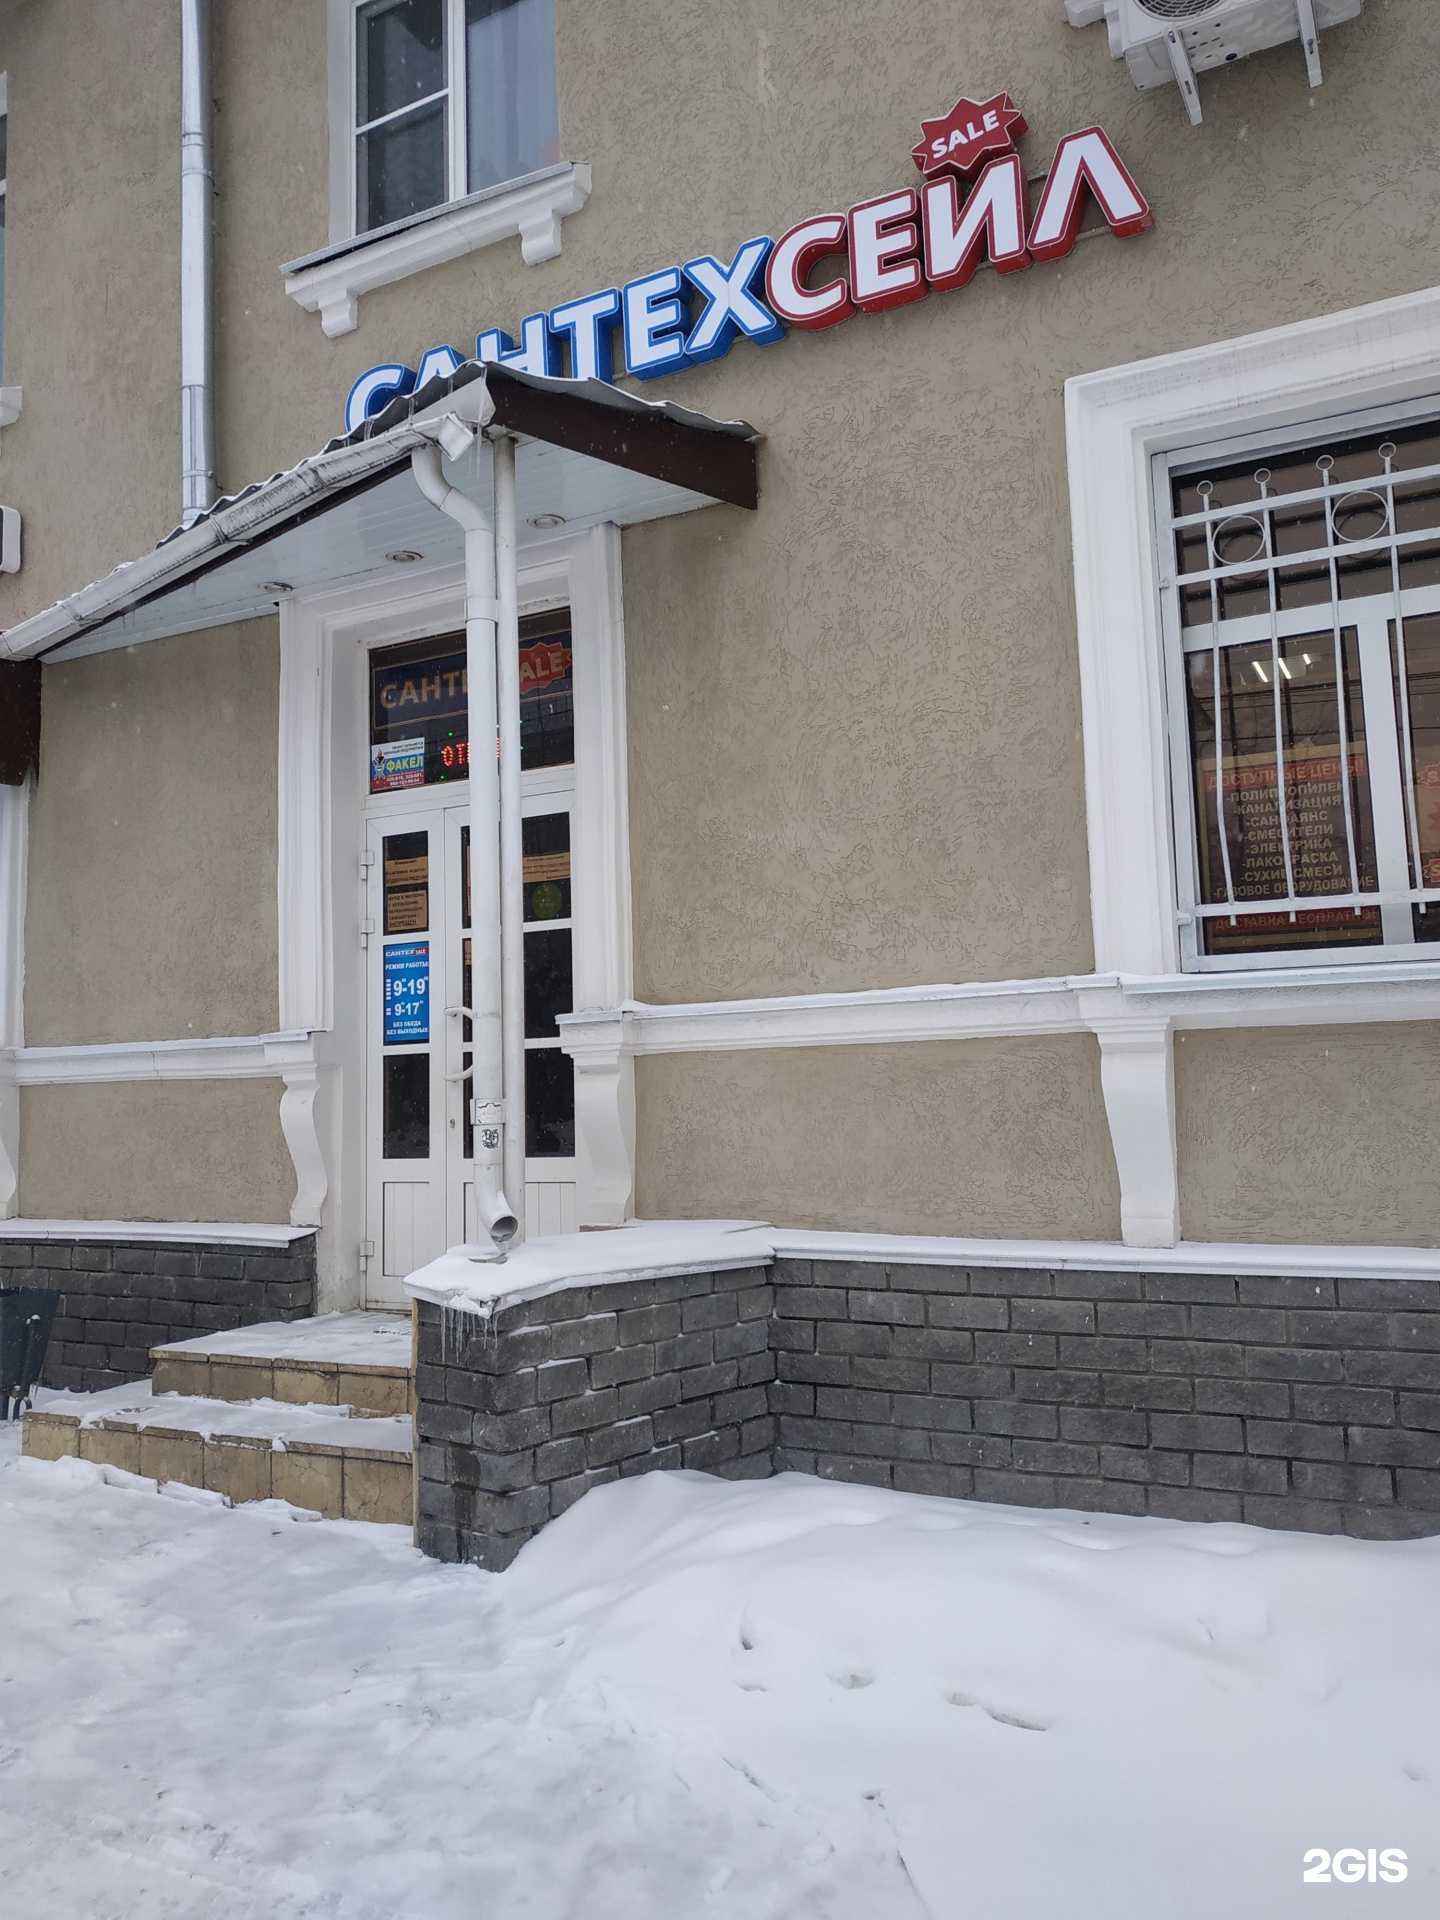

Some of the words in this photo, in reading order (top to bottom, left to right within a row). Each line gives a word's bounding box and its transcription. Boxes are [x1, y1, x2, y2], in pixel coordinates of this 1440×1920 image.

[931, 110, 1000, 158] SALE
[520, 650, 565, 683] ALE
[381, 668, 468, 709] САНТ
[1294, 864, 1343, 878] СМЕСИ
